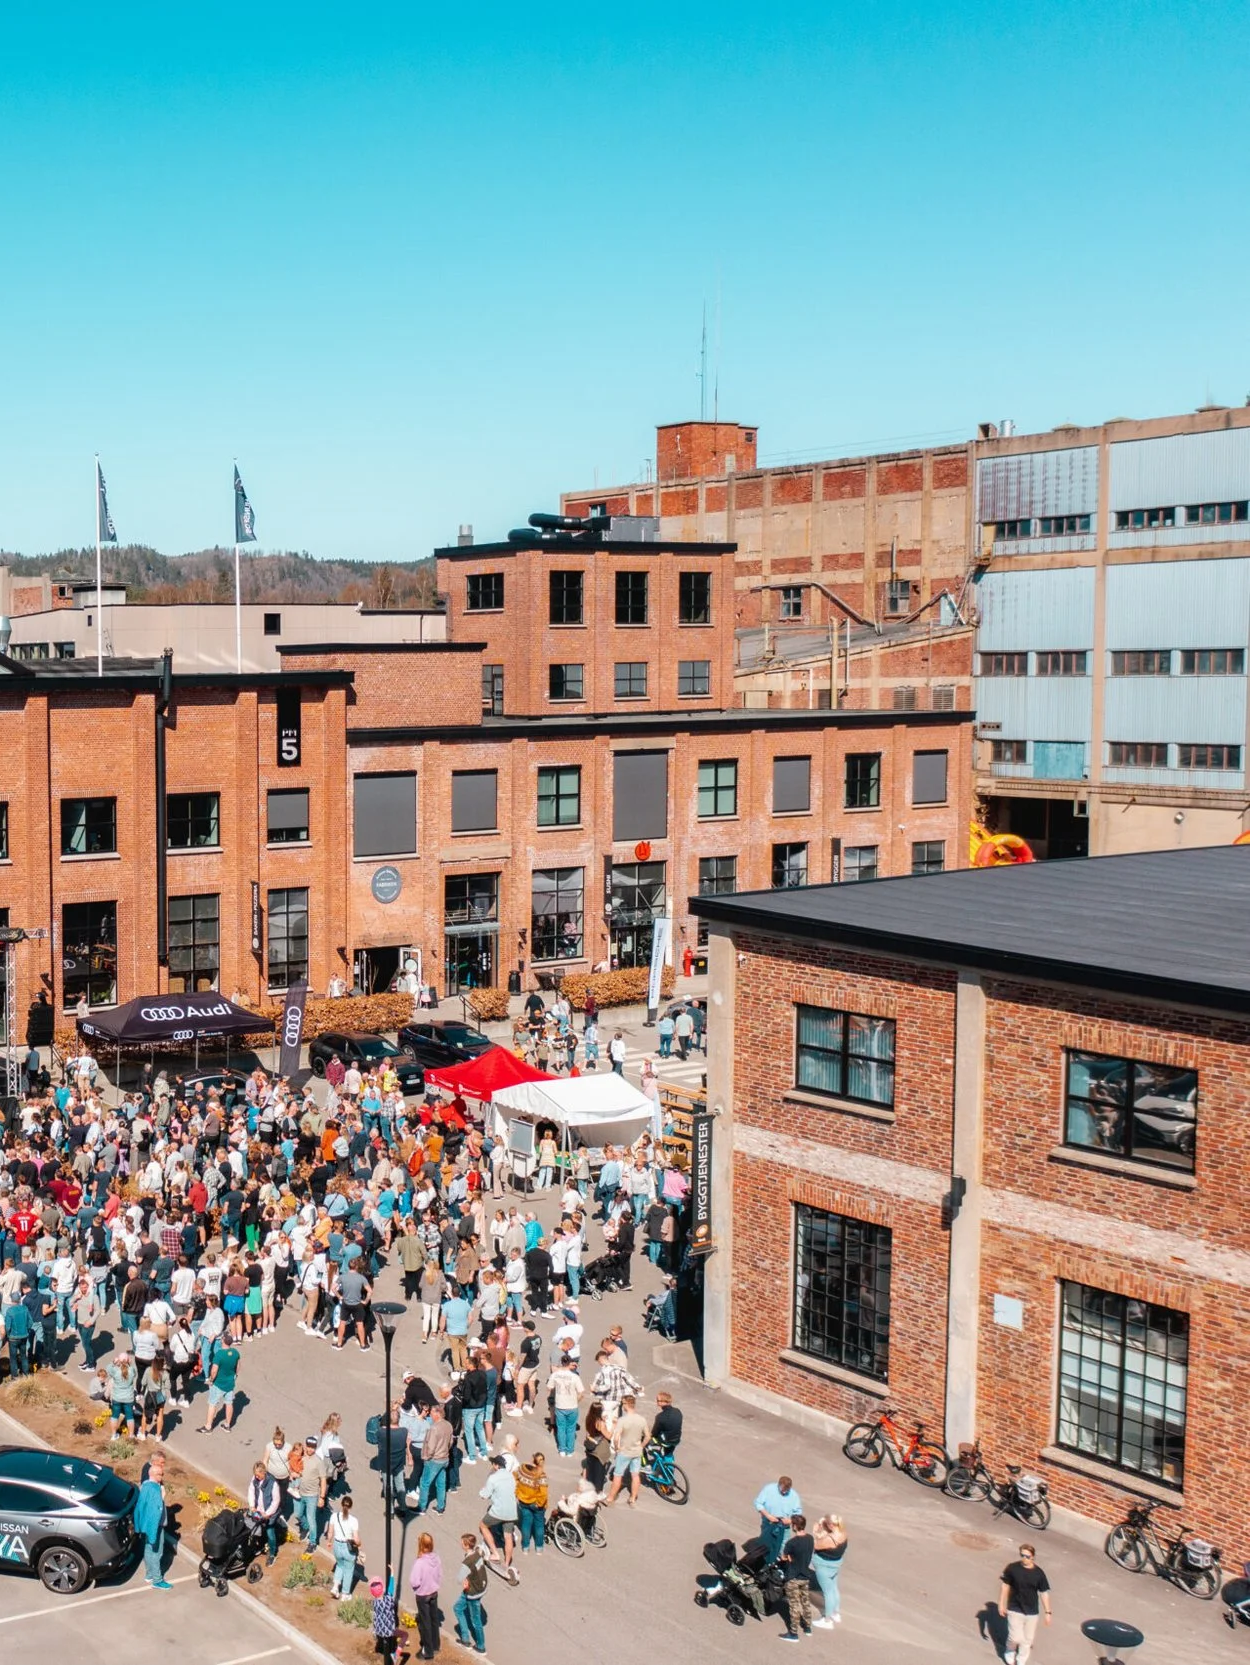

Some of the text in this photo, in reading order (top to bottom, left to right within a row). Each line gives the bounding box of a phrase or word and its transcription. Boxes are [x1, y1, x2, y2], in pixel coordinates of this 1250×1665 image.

[282, 738, 298, 761] 5
[186, 1003, 233, 1018] Audi
[697, 1121, 709, 1221] BYGGTJENESTER
[20, 1220, 28, 1232] 11
